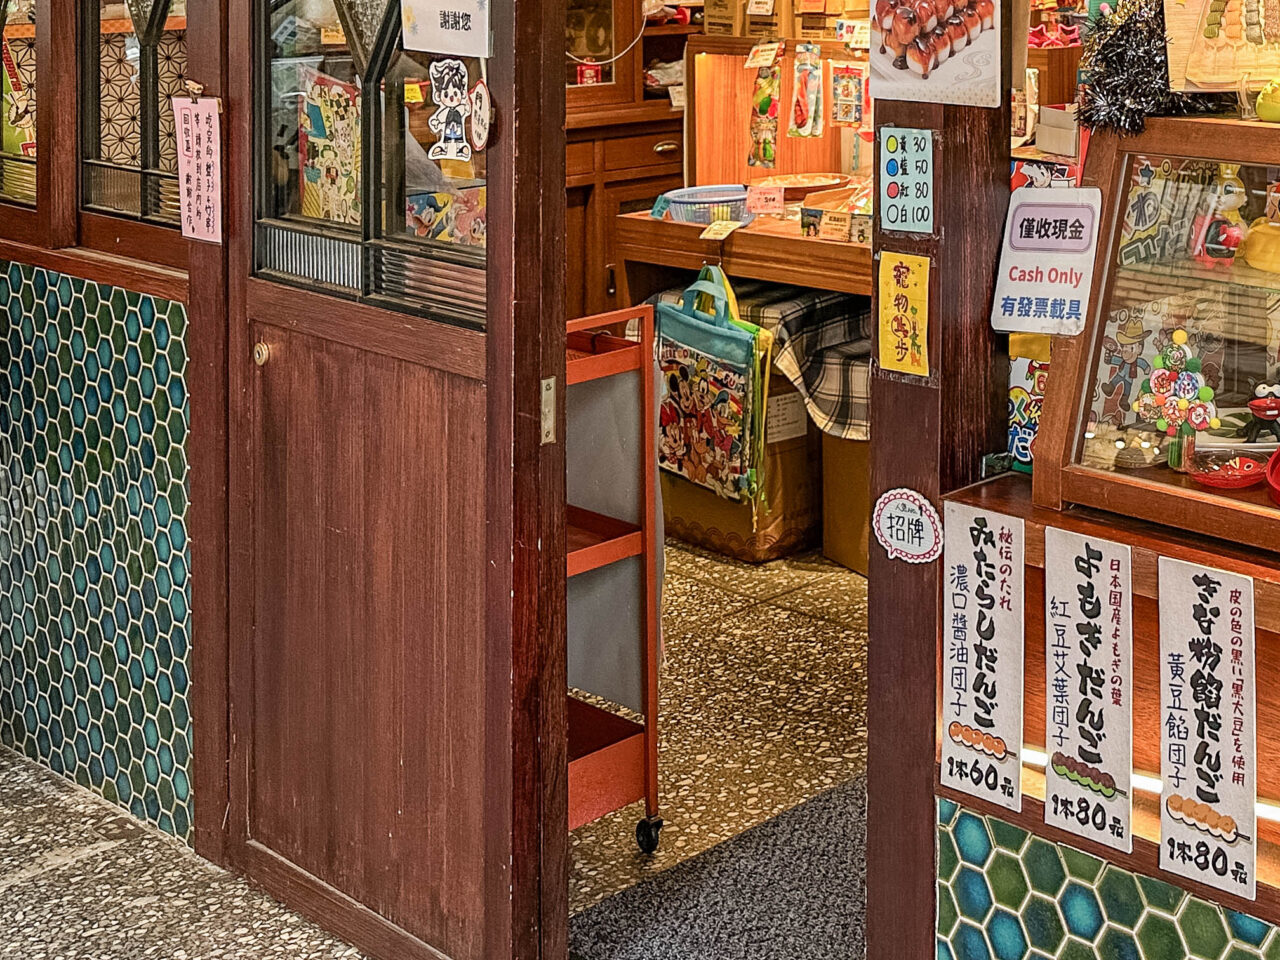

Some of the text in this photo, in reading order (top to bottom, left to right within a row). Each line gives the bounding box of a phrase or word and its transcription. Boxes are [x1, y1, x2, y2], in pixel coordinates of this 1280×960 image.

[440, 10, 472, 32] 謝謝您
[914, 136, 927, 153] 30
[915, 159, 928, 175] 50
[899, 181, 928, 199] 紅 80
[900, 205, 930, 224] 白 100
[1019, 217, 1085, 241] 僅收現金
[1008, 266, 1084, 288] Cash Only
[1000, 296, 1082, 320] 有發票載具
[887, 513, 925, 547] 招牌
[998, 526, 1013, 612] 秘伝のたれ
[969, 517, 998, 729] みたらしだんご
[1108, 558, 1123, 707] 日本国産よもぎの葉
[1074, 542, 1106, 765] よもぎだんご
